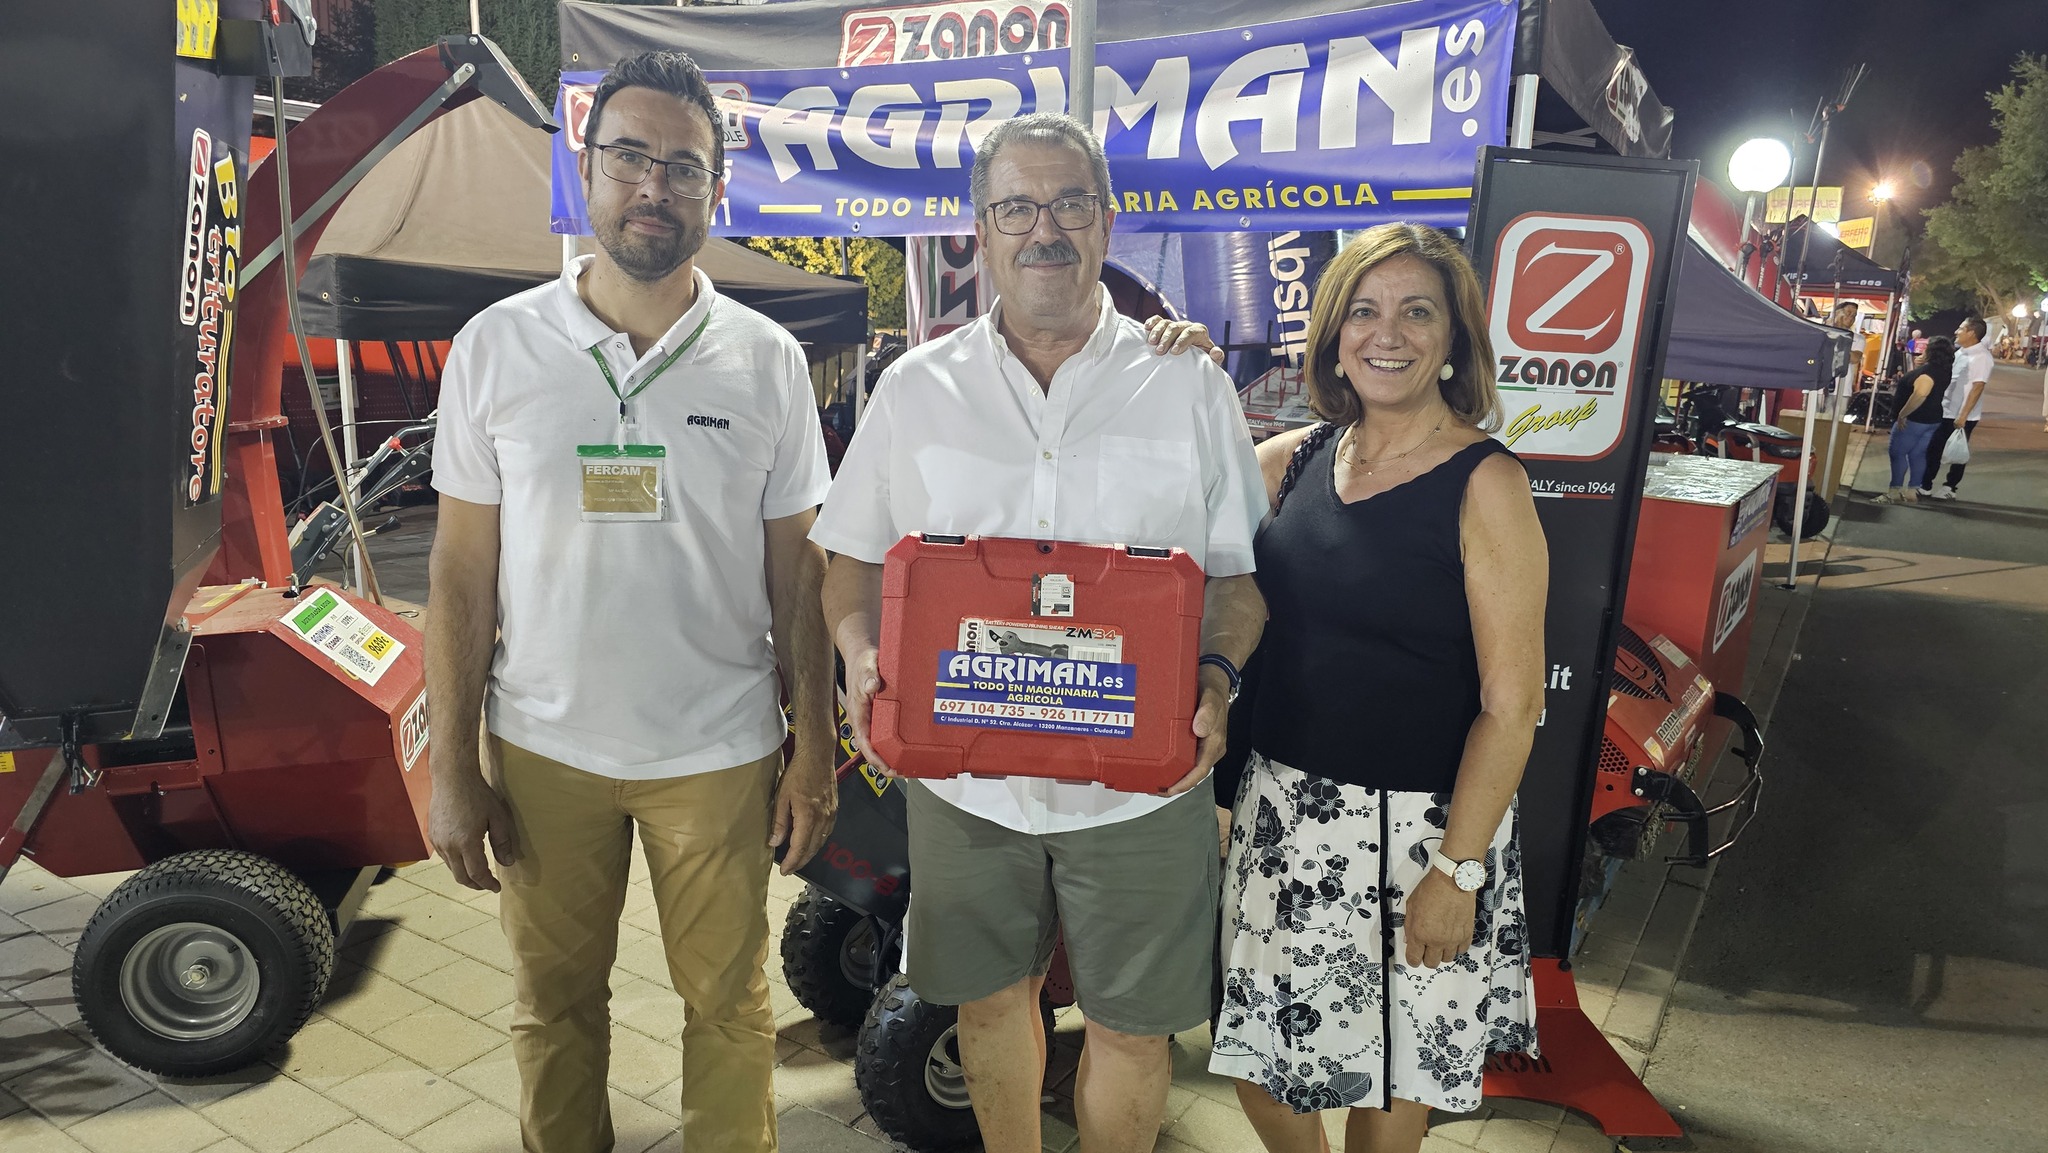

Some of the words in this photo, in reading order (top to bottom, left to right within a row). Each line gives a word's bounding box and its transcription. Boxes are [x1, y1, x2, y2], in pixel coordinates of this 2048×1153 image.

[835, 197, 912, 217] TODO
[924, 196, 960, 217] EN
[1193, 180, 1379, 211] AGRÍCOLA
[687, 414, 730, 430] AGRIMAN
[1505, 397, 1598, 449] Group
[585, 465, 641, 476] FERCAM
[1555, 480, 1586, 493] since
[1587, 481, 1616, 494] 1964
[1065, 626, 1116, 640] ZM34
[973, 681, 1005, 691] TODO
[1008, 684, 1023, 693] EN
[1026, 685, 1099, 698] MAQUINARIA
[939, 700, 966, 713] 697
[971, 702, 995, 715] 104
[1000, 705, 1025, 717] 735
[1040, 708, 1066, 720] 926
[1072, 710, 1086, 721] 11
[1092, 711, 1109, 723] 77
[1114, 713, 1128, 725] 11
